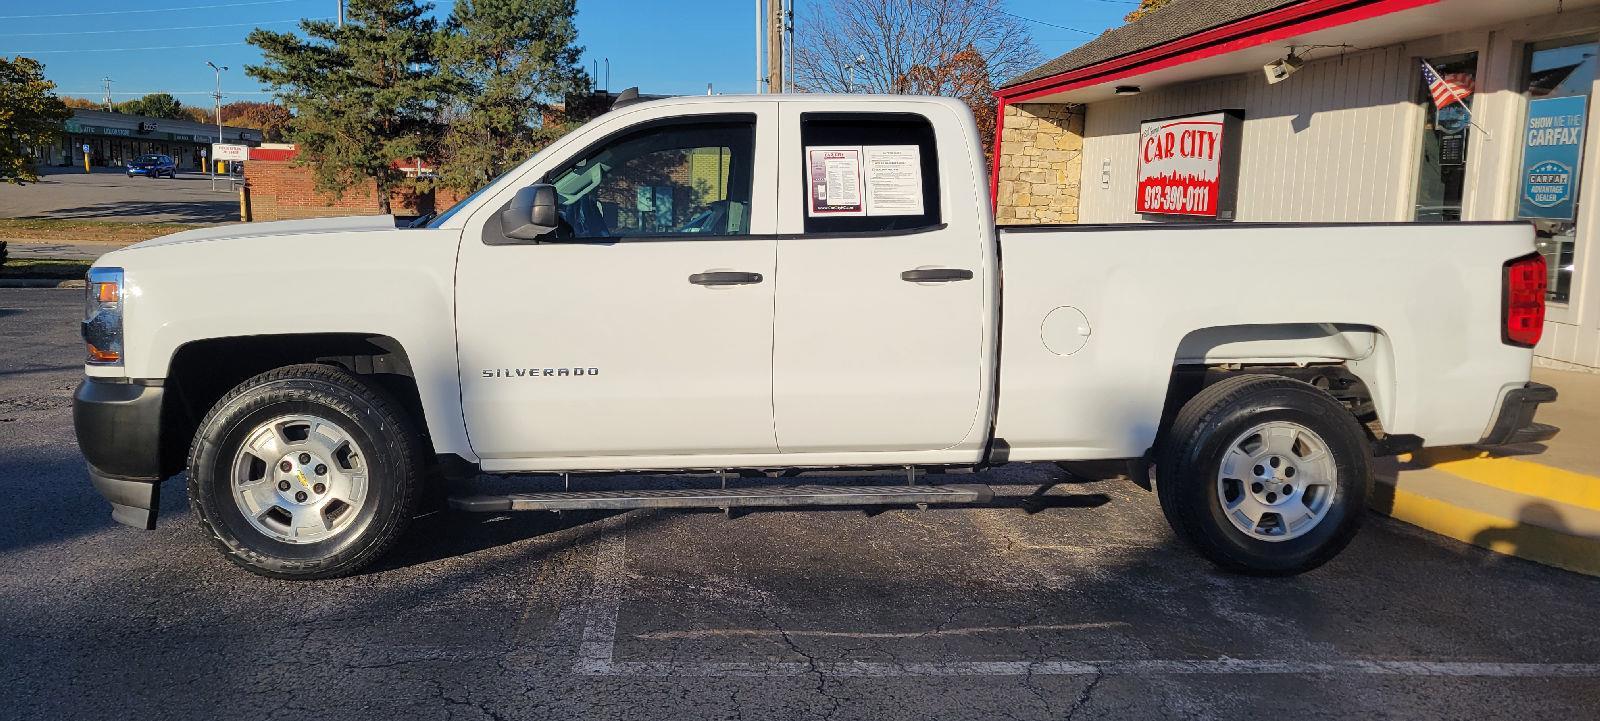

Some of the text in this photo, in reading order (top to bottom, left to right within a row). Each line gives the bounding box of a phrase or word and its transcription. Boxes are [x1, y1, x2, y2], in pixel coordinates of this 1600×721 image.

[1529, 114, 1582, 129] SHOW ME THE
[1528, 128, 1579, 147] CARFAX
[1144, 130, 1218, 164] CAR CITY
[1529, 174, 1567, 184] CARFAX
[1531, 185, 1563, 193] ADVANTAGE
[1144, 185, 1209, 212] 913-390-0111
[1535, 194, 1557, 202] DEALER
[482, 367, 599, 378] SILVERADO
